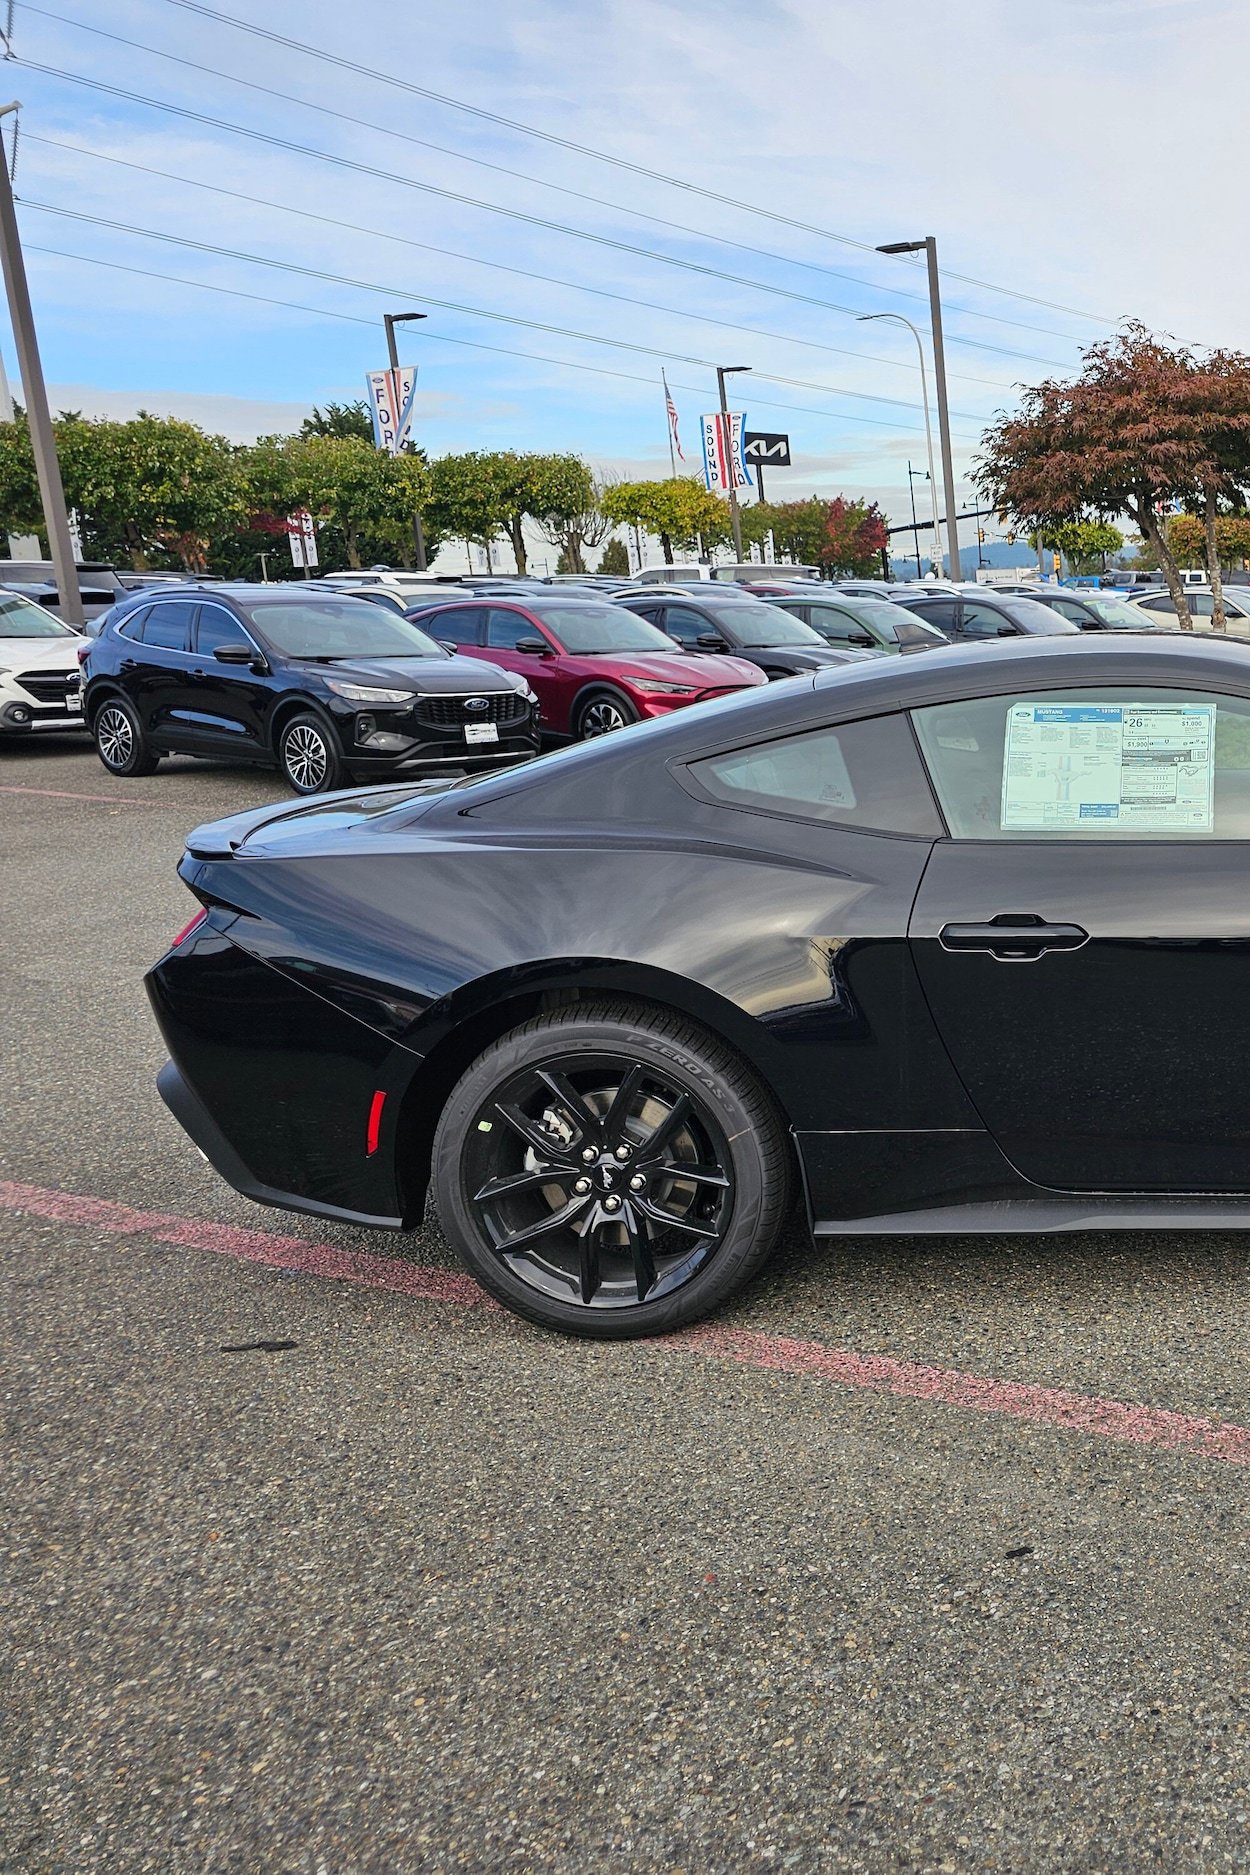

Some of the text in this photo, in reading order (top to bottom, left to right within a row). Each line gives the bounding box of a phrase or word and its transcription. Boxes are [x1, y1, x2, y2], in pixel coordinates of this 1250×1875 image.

[706, 424, 719, 481] SOUND
[731, 423, 746, 485] FORD
[1129, 718, 1143, 728] 26
[646, 1042, 702, 1075] ZERO
[700, 1078, 726, 1099] AS
[723, 1103, 736, 1113] 3
